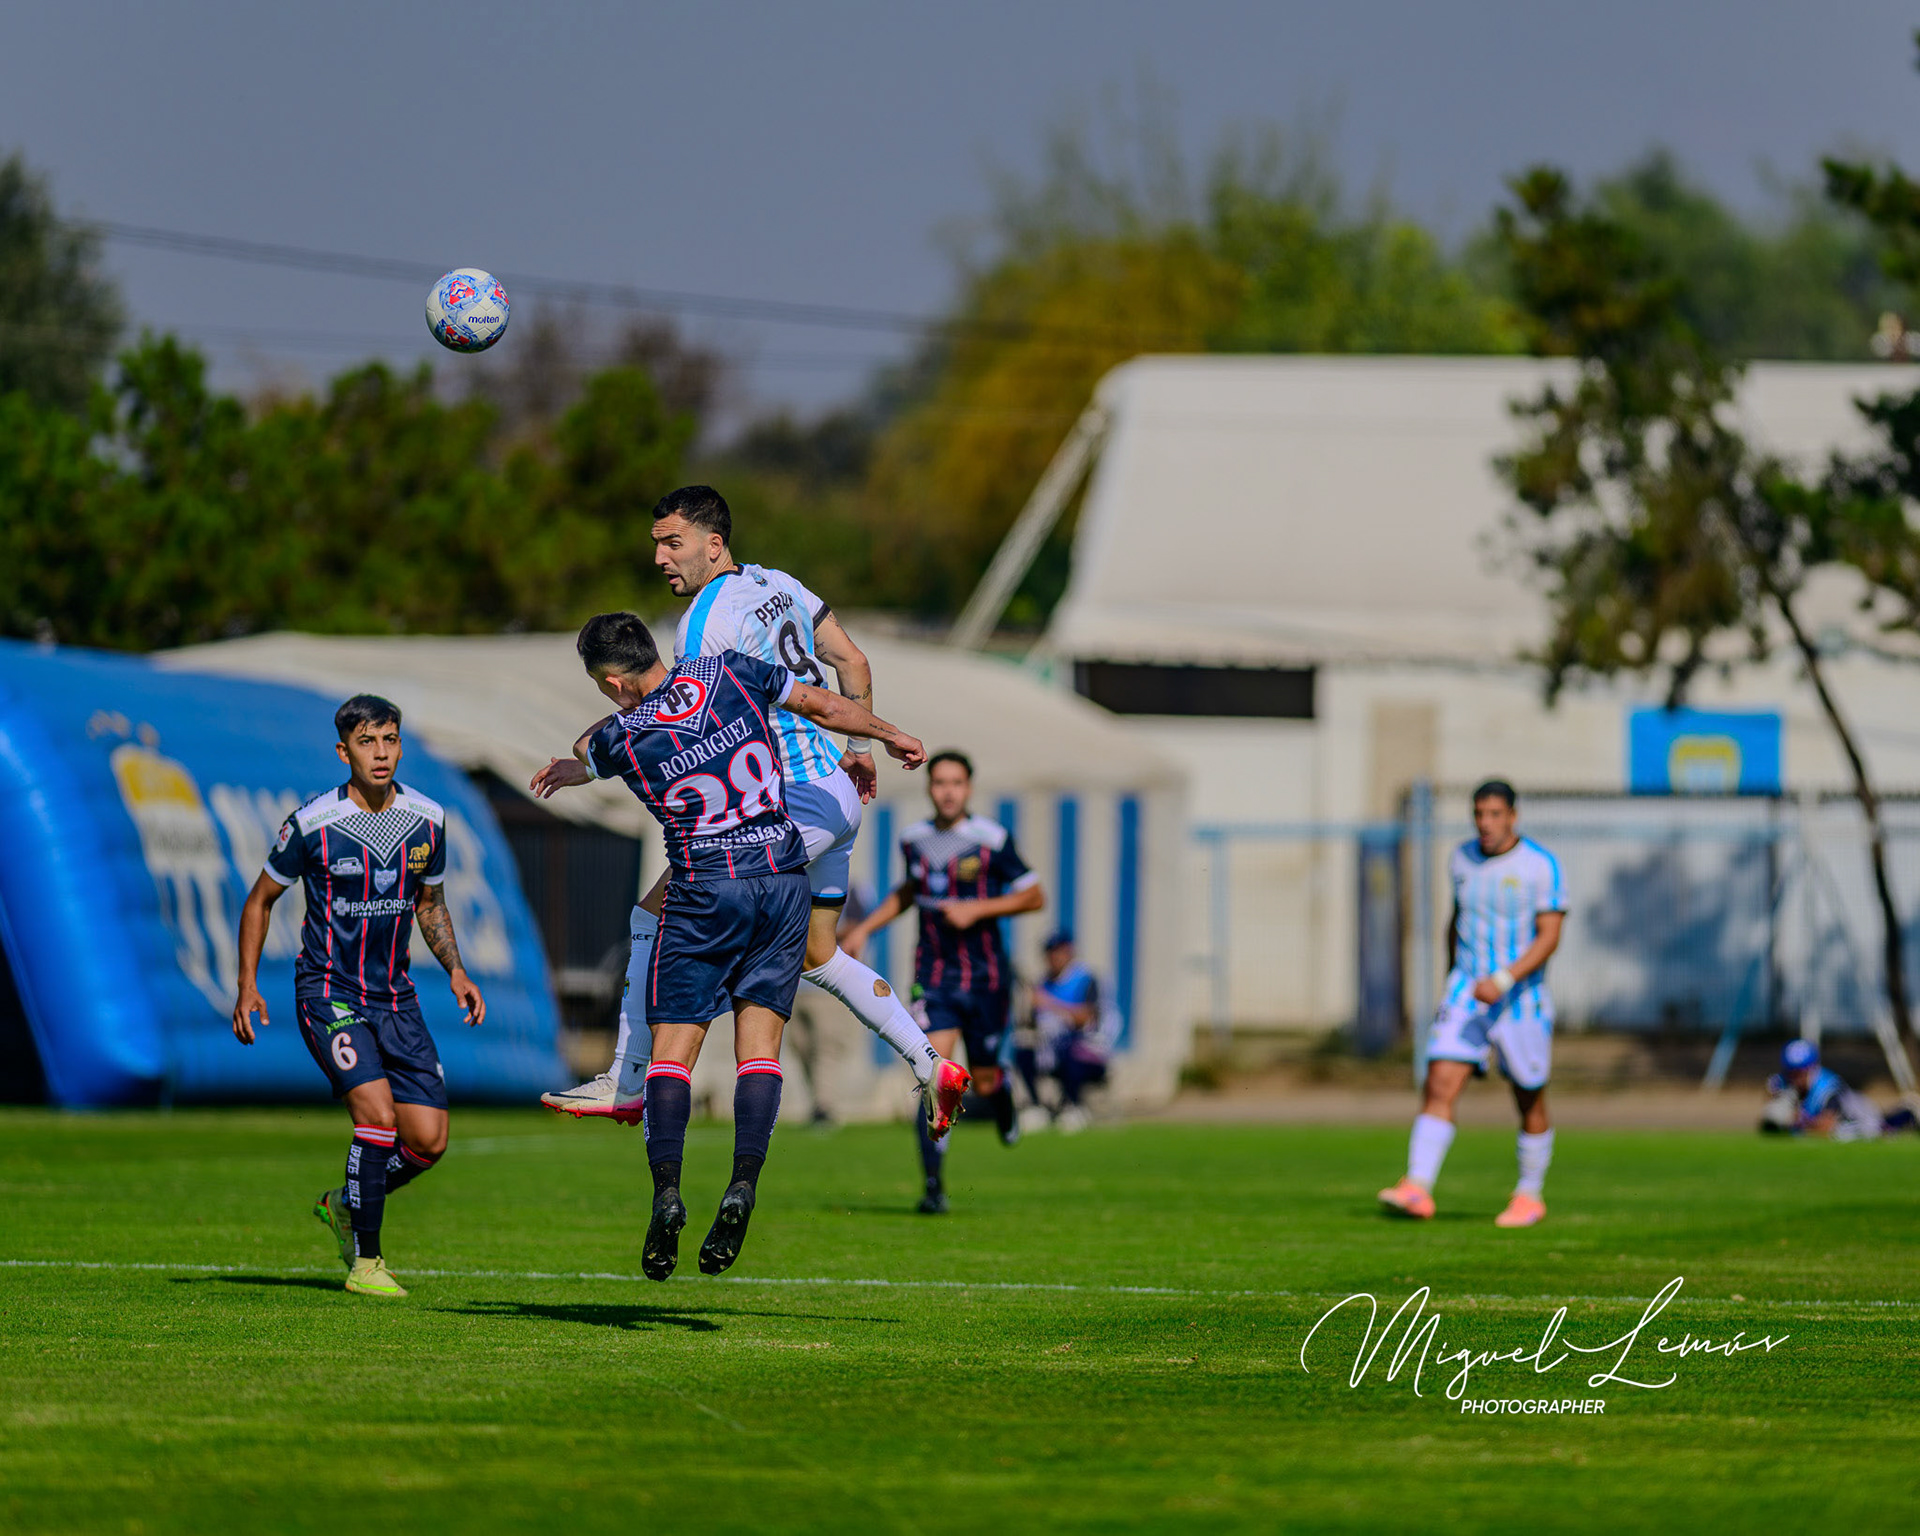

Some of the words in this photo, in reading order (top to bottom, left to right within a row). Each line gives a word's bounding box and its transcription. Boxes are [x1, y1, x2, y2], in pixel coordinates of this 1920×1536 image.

[468, 315, 499, 324] molten
[779, 620, 824, 687] 9
[665, 682, 694, 714] PF
[658, 717, 753, 781] RODRIGUEZ
[663, 740, 778, 837] 28
[351, 899, 407, 913] BRADFORD
[331, 1032, 358, 1071] 6
